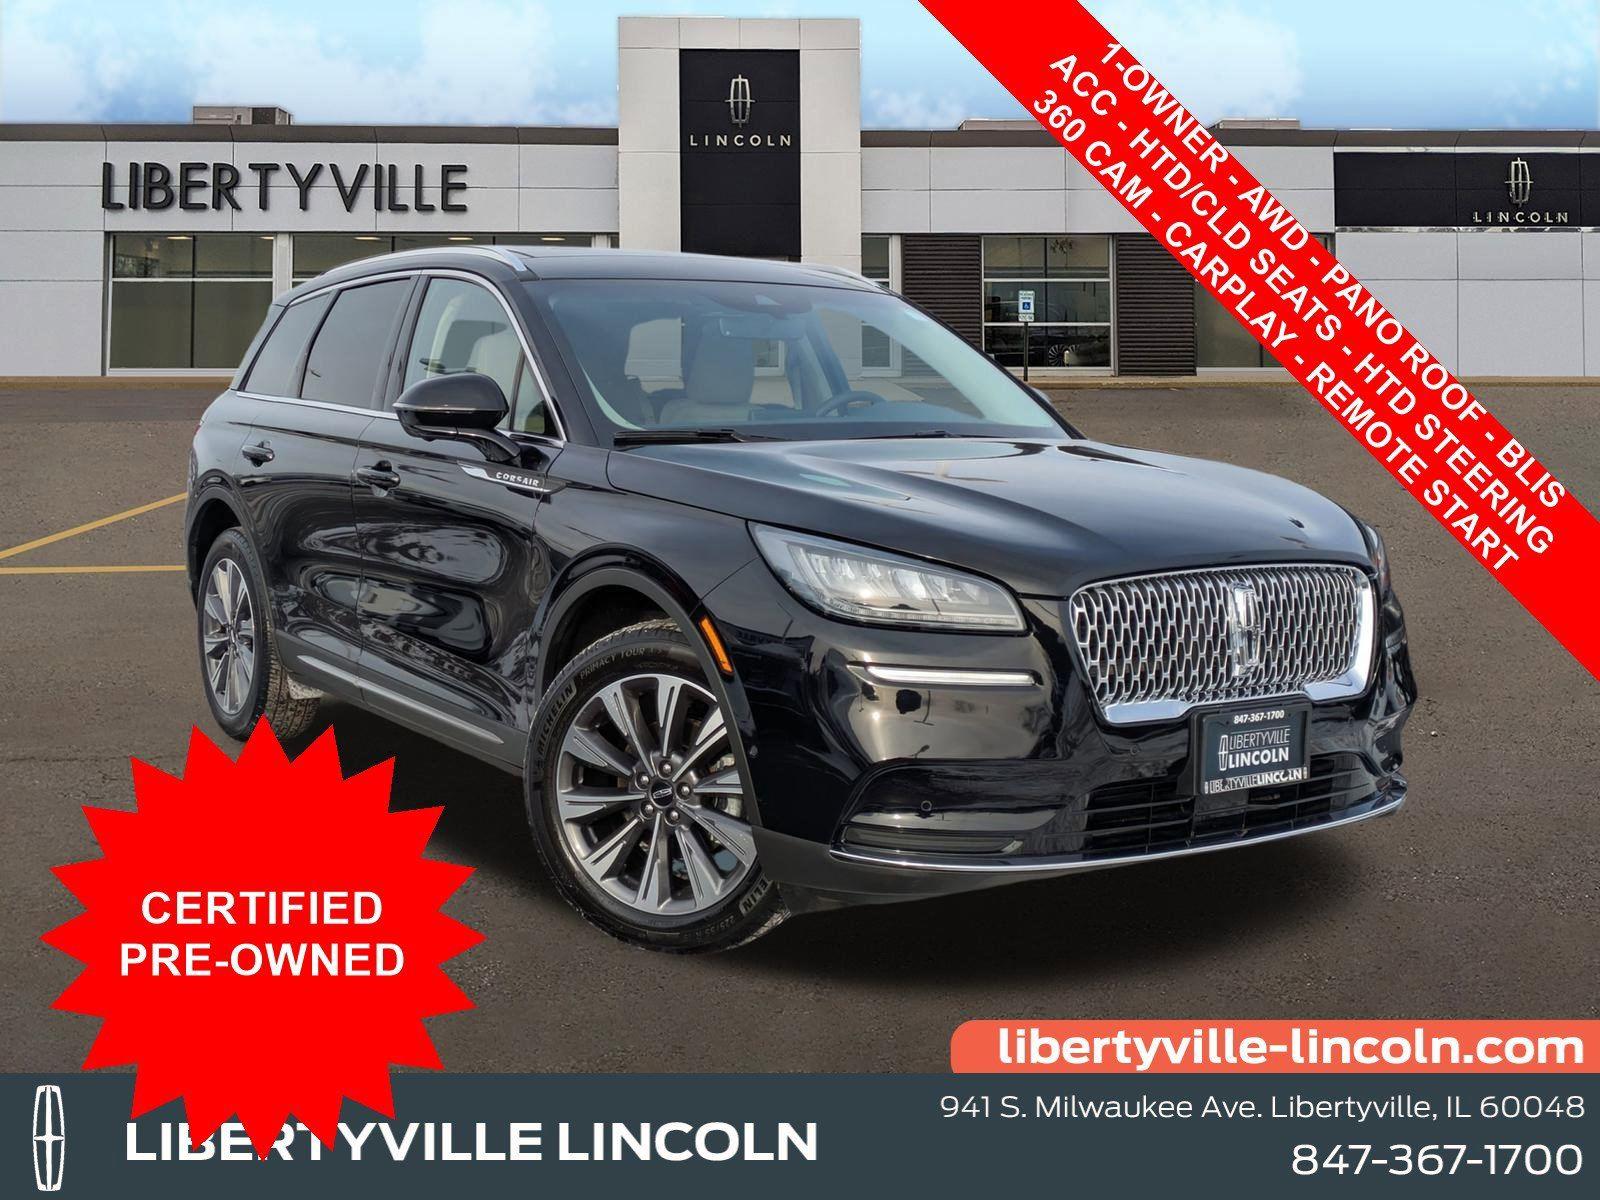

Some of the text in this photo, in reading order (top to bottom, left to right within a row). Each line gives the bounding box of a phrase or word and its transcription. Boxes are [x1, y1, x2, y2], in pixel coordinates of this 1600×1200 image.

[690, 134, 791, 147] LINCOLN
[101, 161, 469, 214] LIBERTYVILLE
[1473, 211, 1568, 223] LINCOLN
[495, 472, 540, 487] CORSAIR
[1233, 709, 1285, 724] 847-367-1700
[1229, 728, 1291, 750] LIBERTYVILLE
[1228, 747, 1290, 769] LINCOLN
